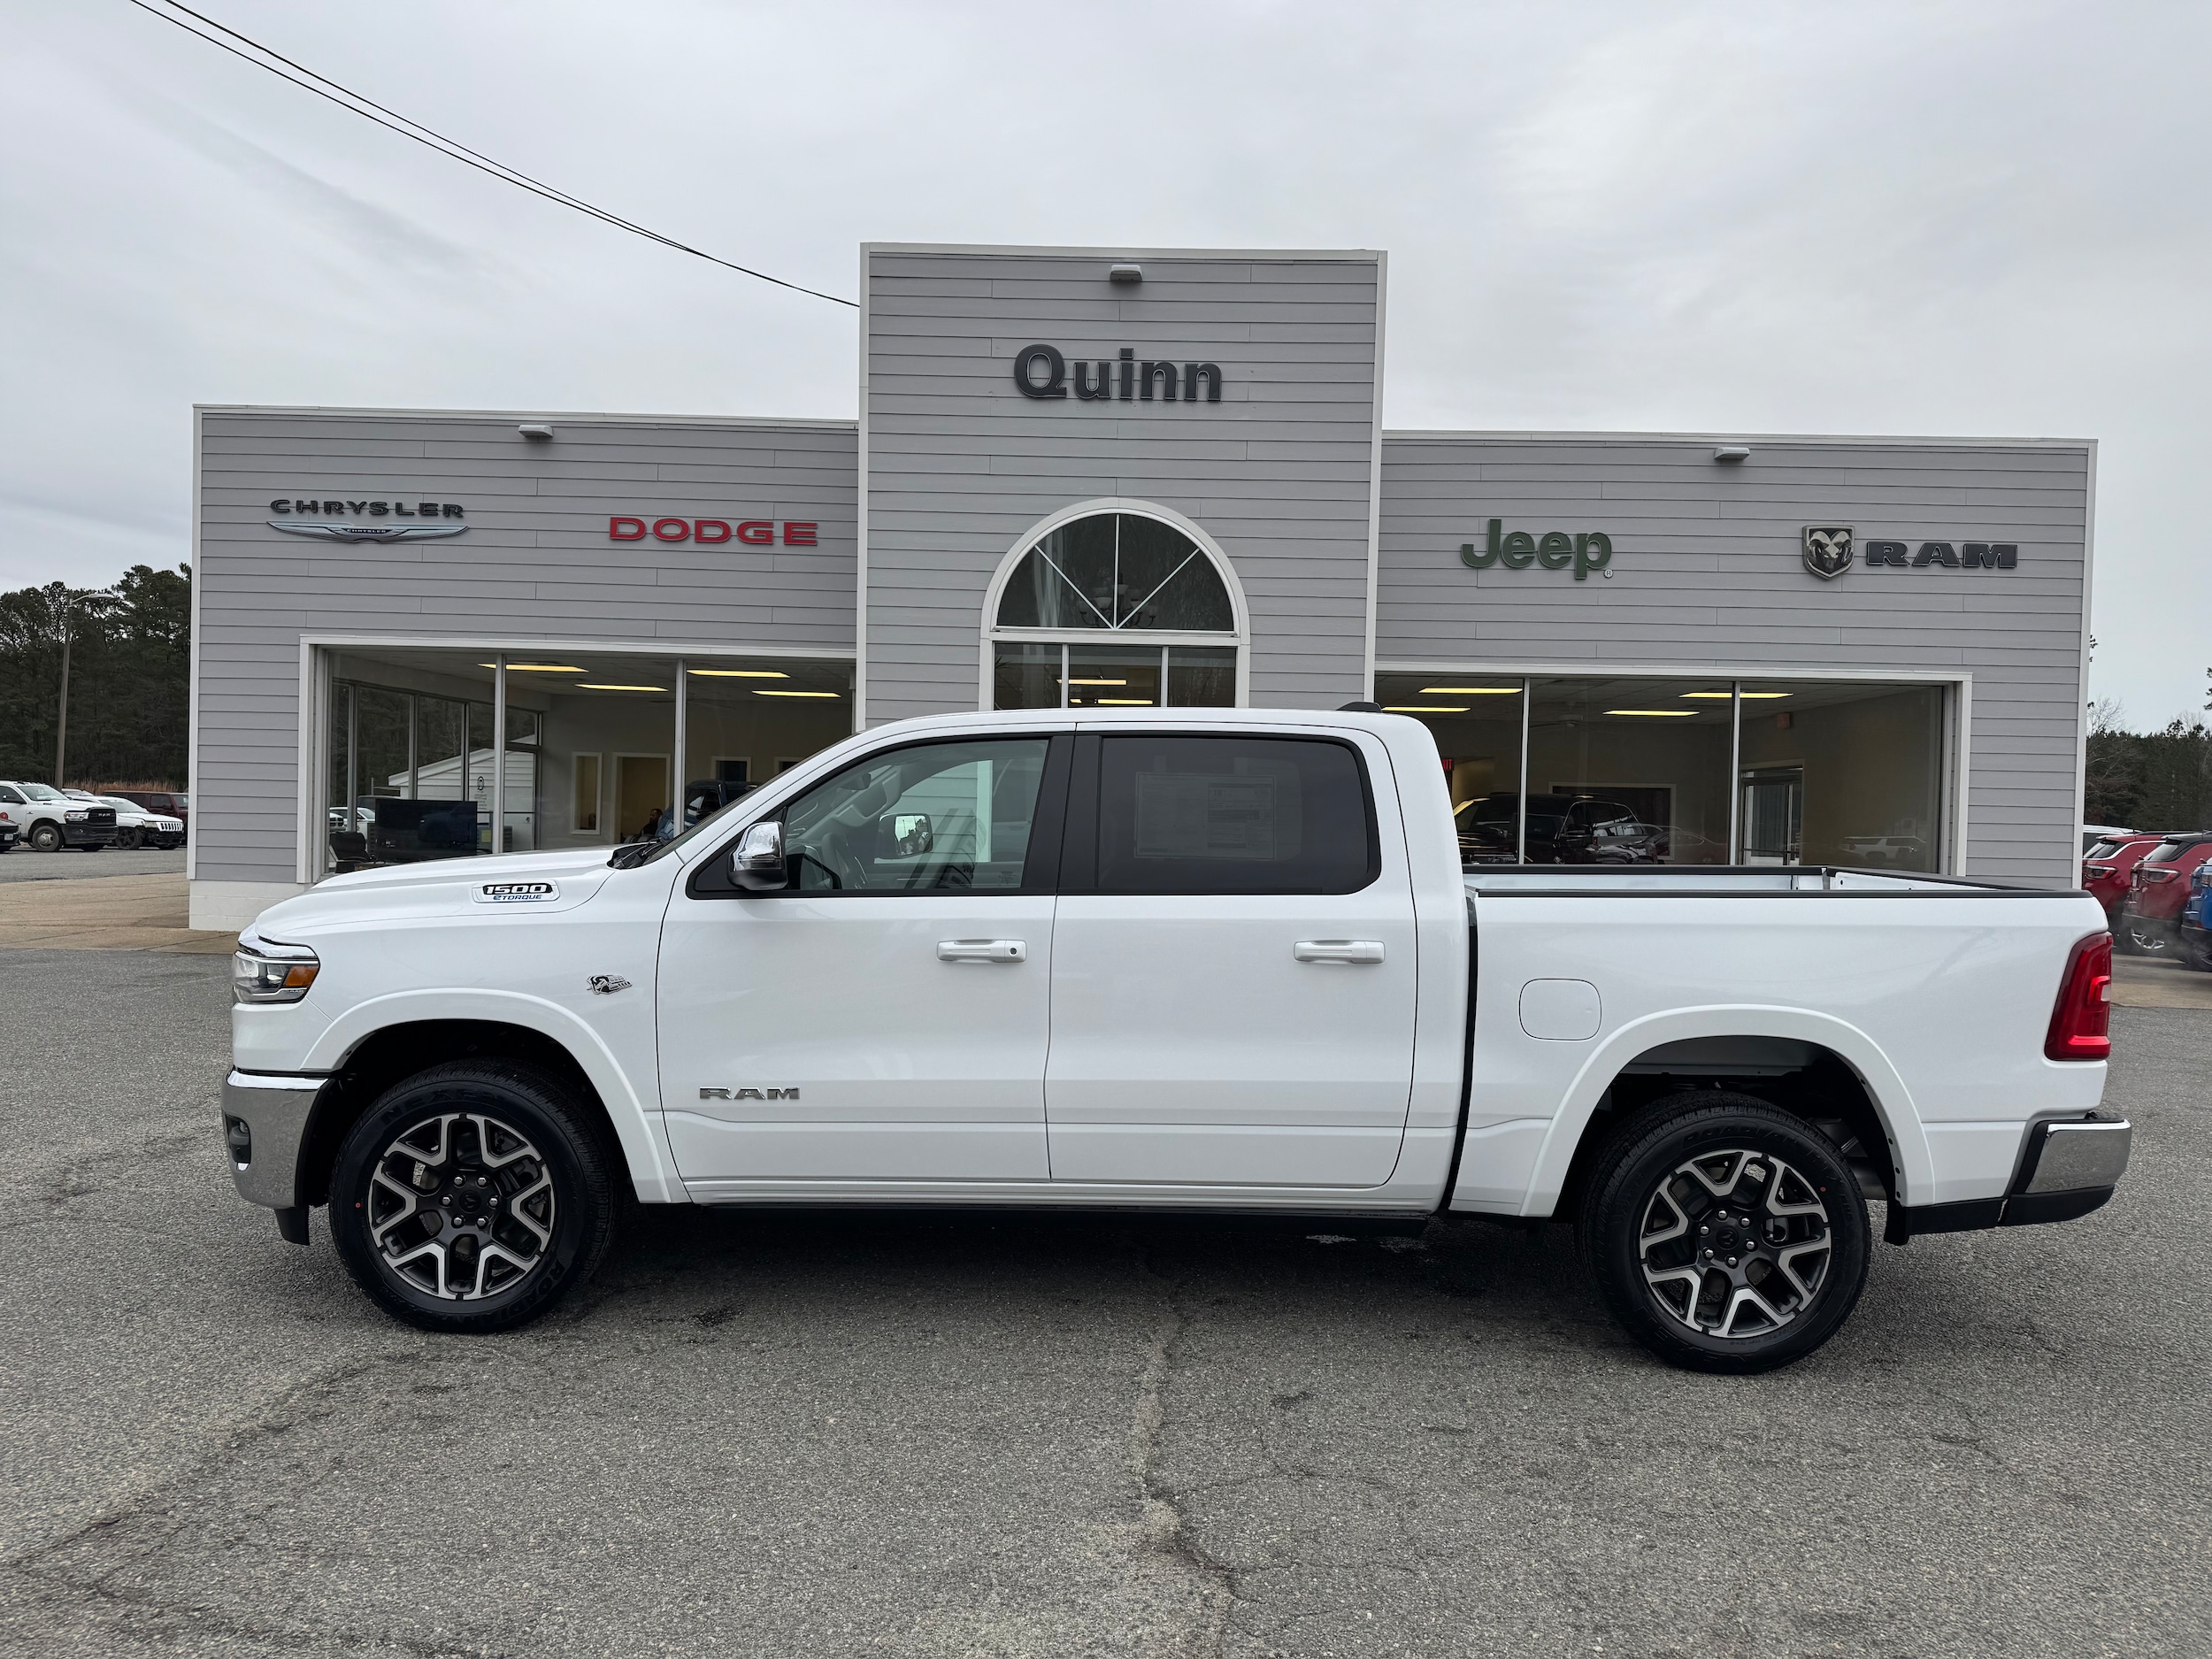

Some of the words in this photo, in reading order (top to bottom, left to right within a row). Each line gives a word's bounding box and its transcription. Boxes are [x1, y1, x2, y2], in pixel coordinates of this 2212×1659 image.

[1014, 344, 1222, 401] Quinn
[270, 499, 464, 518] CHRYSLER
[610, 517, 818, 546] DODGE
[1461, 518, 1612, 580] Jeep
[1866, 541, 2018, 568] RAM
[486, 885, 547, 895] 1500
[699, 1087, 800, 1100] RAM
